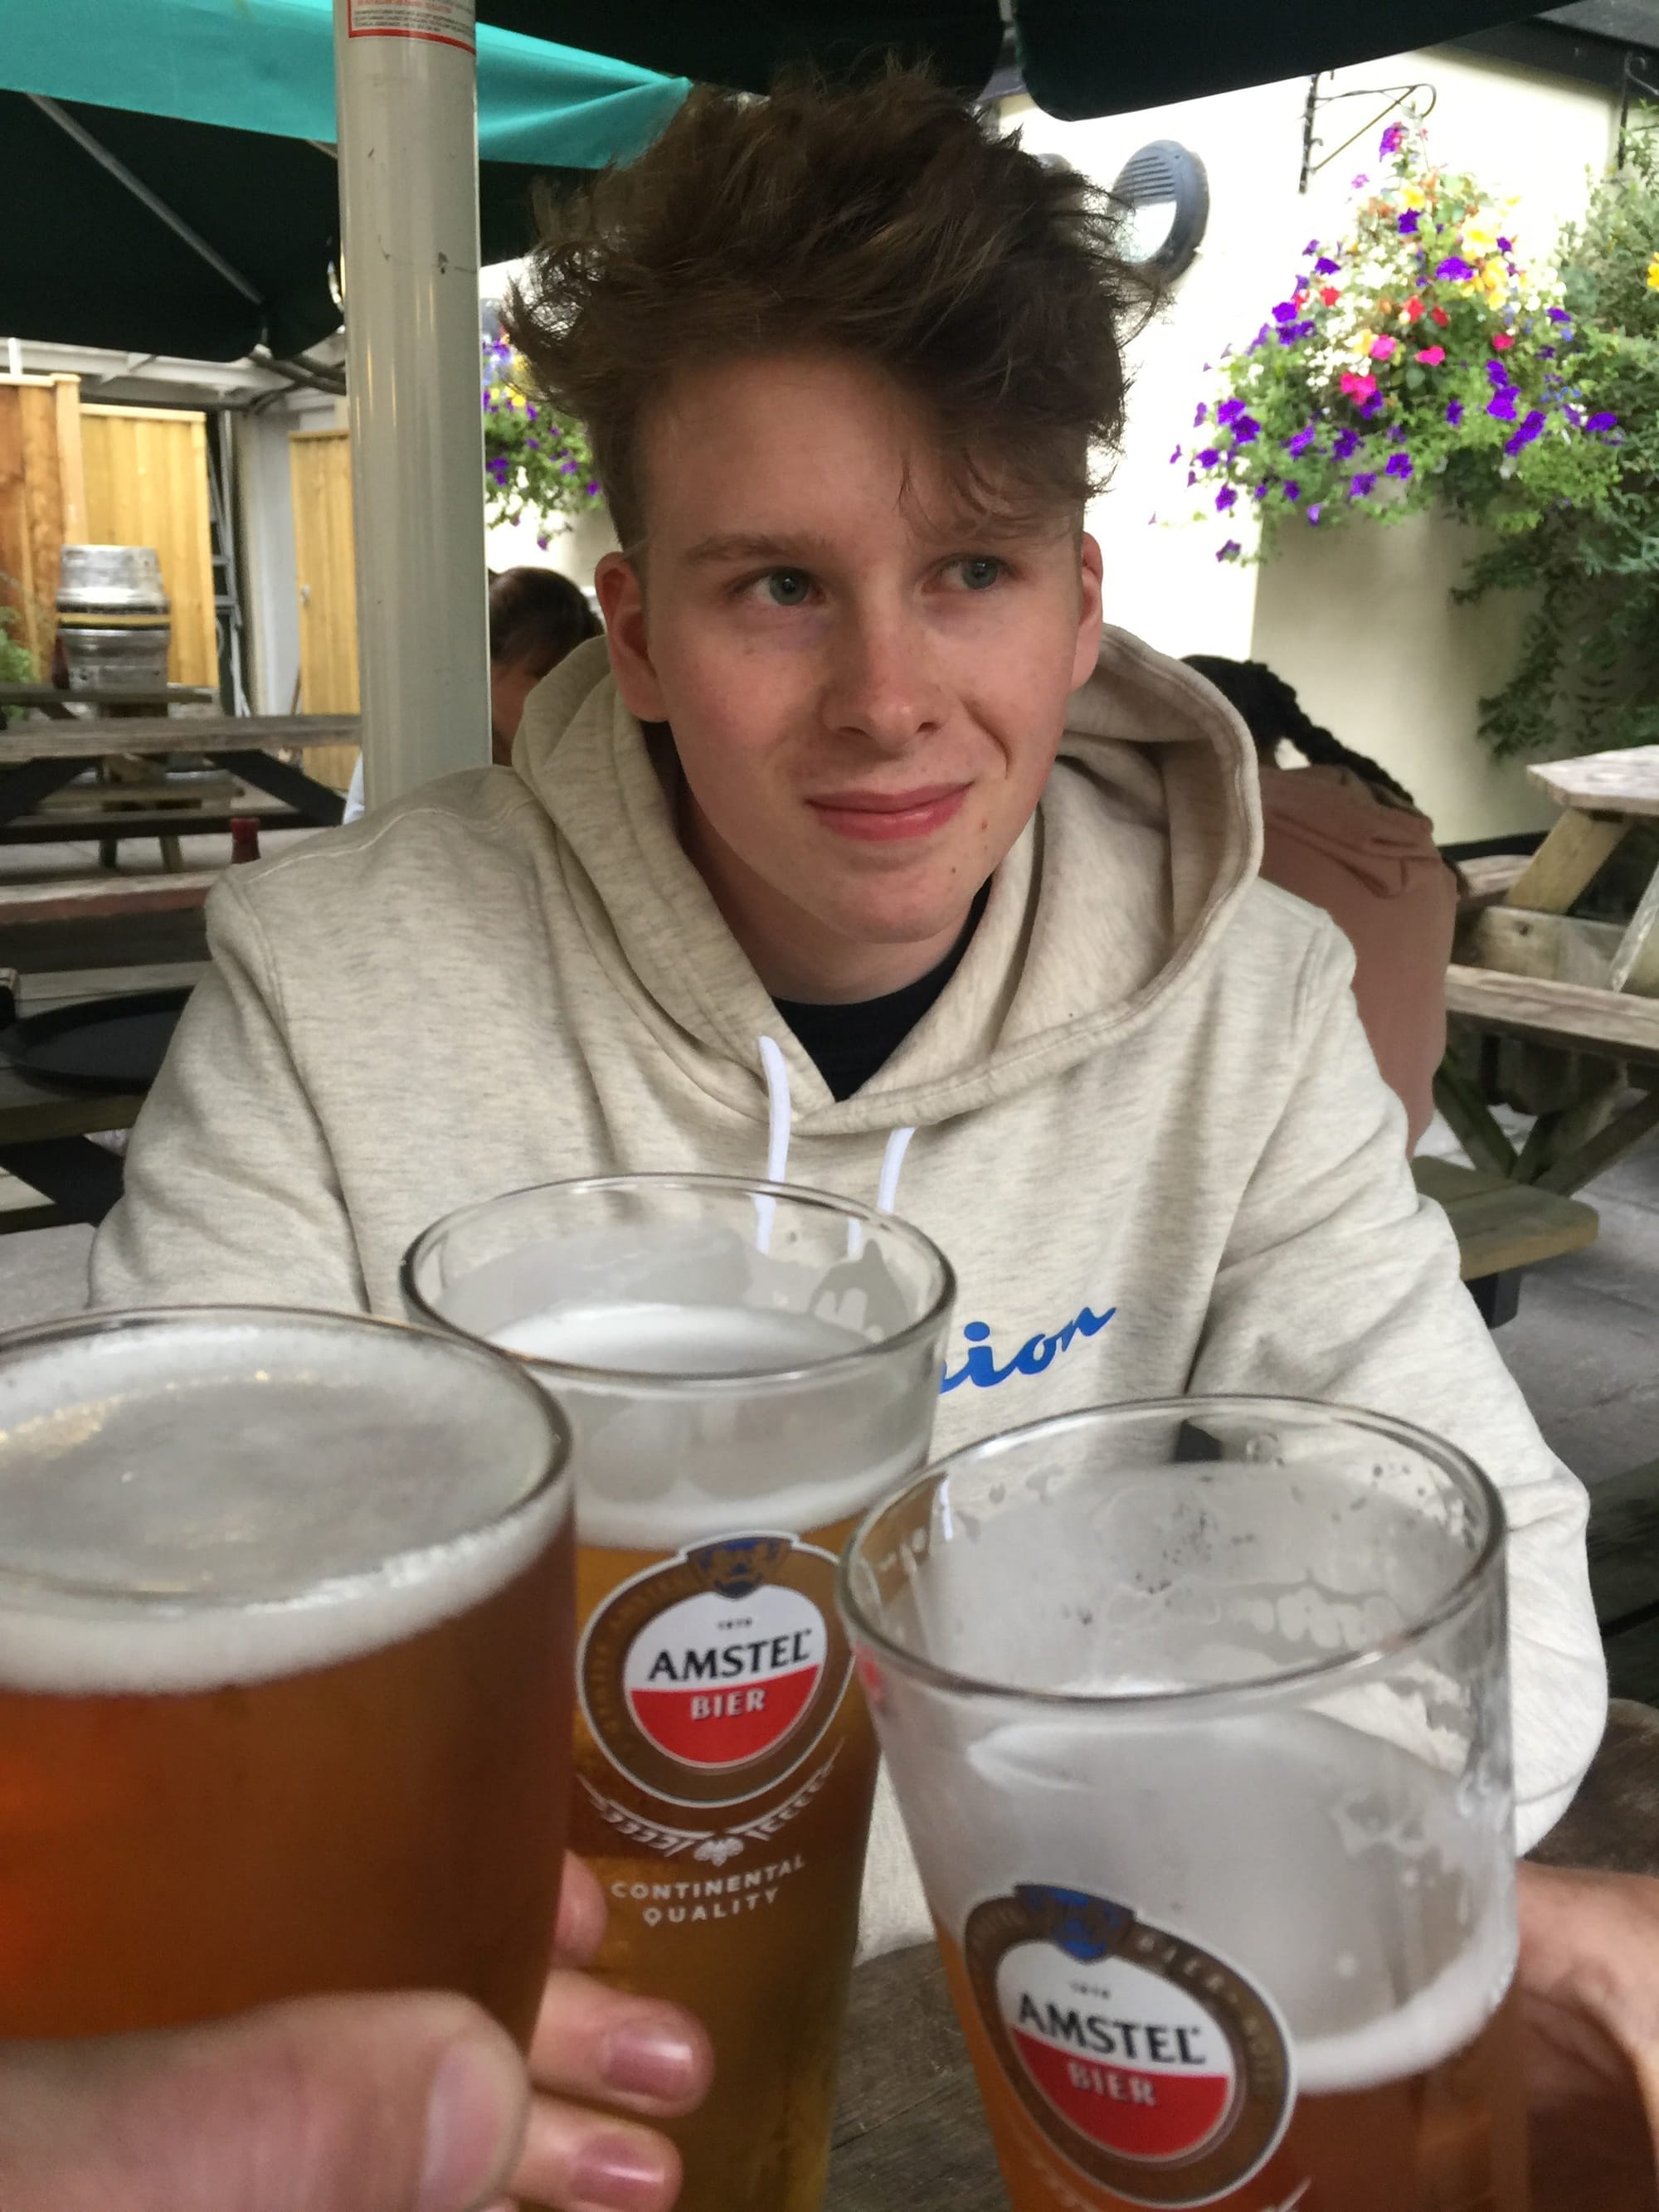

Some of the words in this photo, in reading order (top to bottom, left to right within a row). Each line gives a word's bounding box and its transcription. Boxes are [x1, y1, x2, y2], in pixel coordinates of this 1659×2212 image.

[938, 1306, 1117, 1395] ion
[647, 1629, 812, 1683] AMSTEL
[690, 1689, 766, 1720] BIER
[611, 1855, 805, 1899] CONTINENTAL
[643, 1887, 779, 1927] QUALITY
[1018, 1992, 1206, 2065] AMSTEL
[1068, 2062, 1156, 2107] BIER
